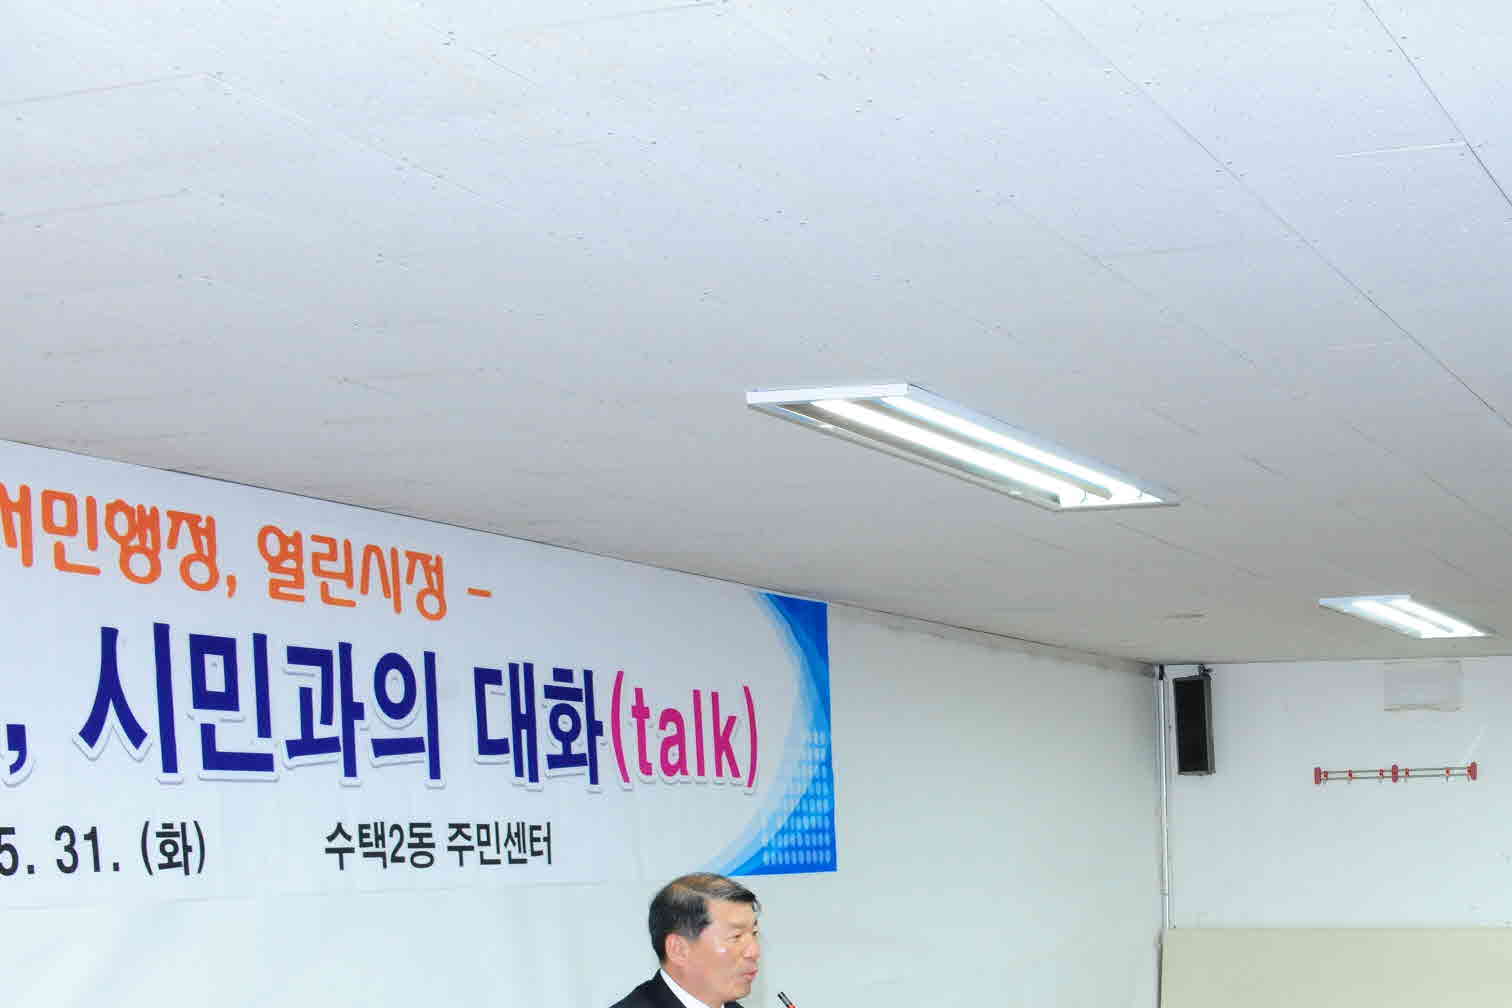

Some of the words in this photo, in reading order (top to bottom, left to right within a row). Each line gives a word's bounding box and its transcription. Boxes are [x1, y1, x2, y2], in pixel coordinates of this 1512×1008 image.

[257, 525, 448, 621] 열린시정
[78, 621, 441, 780] 시민과의
[474, 661, 759, 788] 대화(talk)
[54, 825, 121, 874] 31.
[140, 820, 206, 876] (화)
[324, 821, 436, 871] 수택2동
[447, 821, 552, 867] 주민센터
